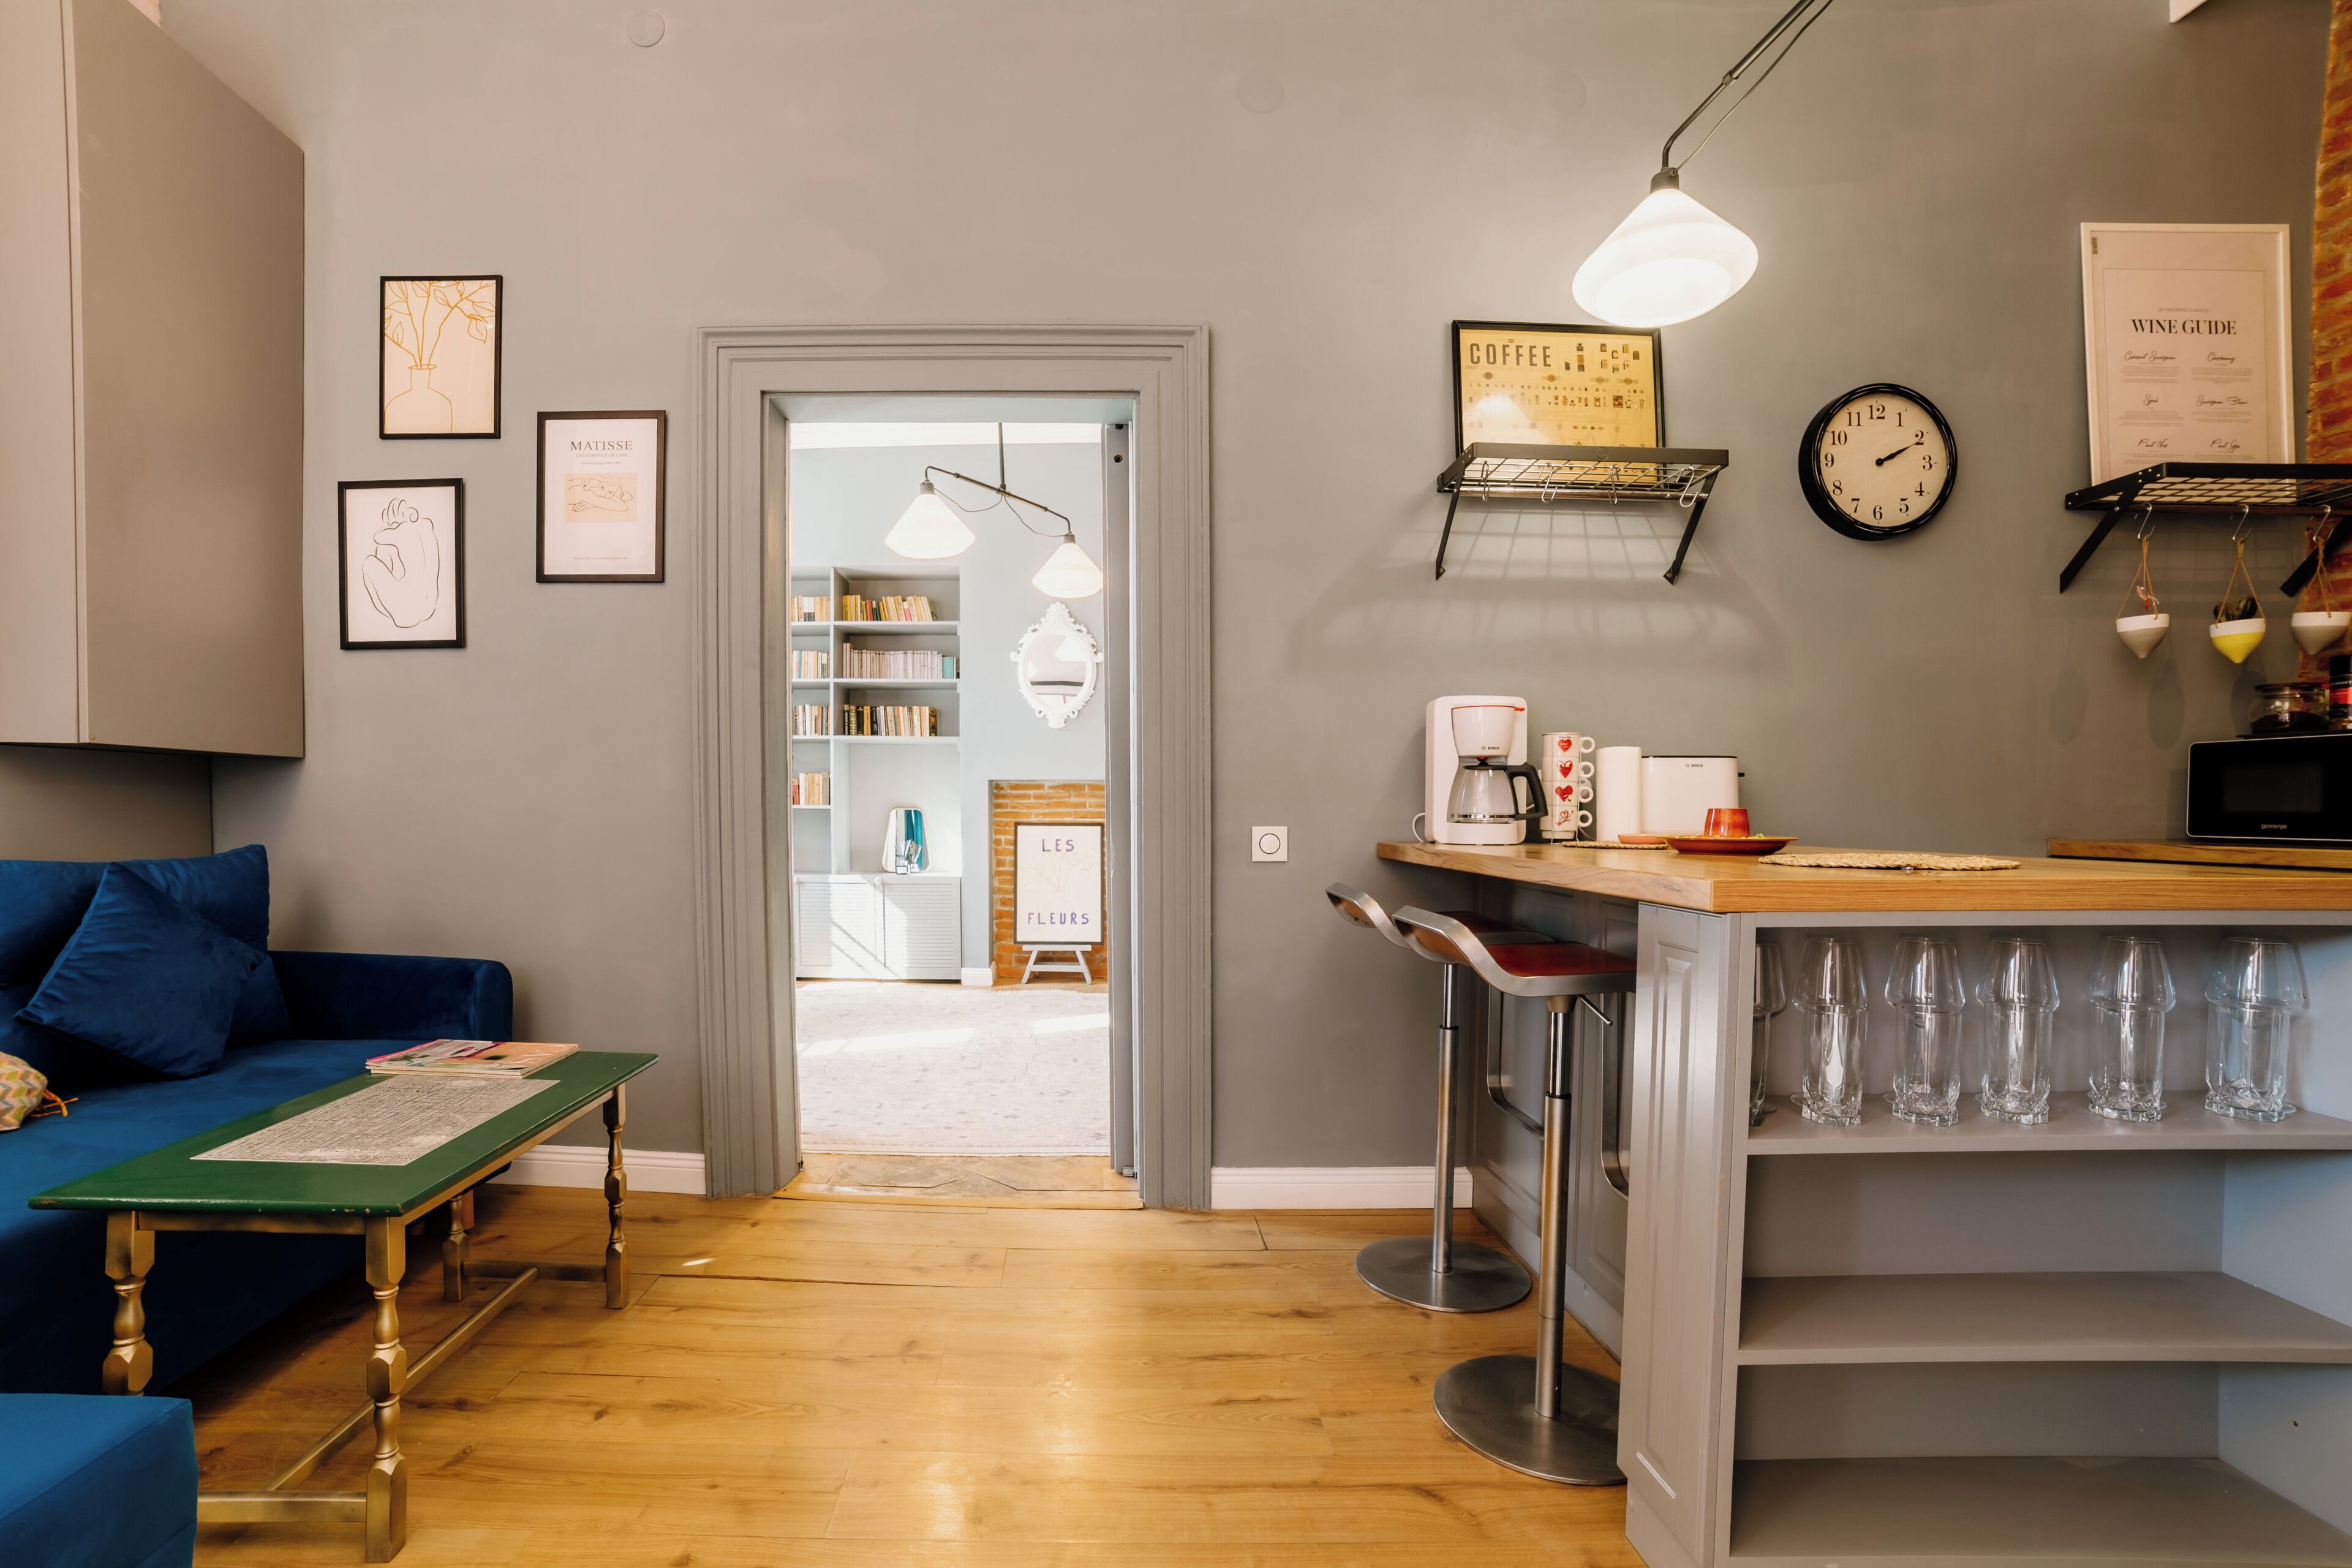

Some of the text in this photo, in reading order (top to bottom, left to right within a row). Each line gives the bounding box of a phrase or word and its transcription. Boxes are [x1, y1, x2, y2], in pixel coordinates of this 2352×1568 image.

[2132, 319, 2236, 335] WINE GUIDE
[1470, 343, 1551, 367] COFFEE
[1845, 411, 1863, 426] 11
[1868, 404, 1886, 420] 12
[1896, 412, 1904, 427] 1
[1829, 430, 1847, 445] 10
[1914, 430, 1924, 445] 2
[570, 440, 633, 451] MATISSE
[1824, 453, 1834, 468] 9
[1922, 454, 1932, 470] 3
[1832, 480, 1842, 496] 8
[1914, 481, 1924, 496] 4
[1851, 498, 1860, 513] 7
[1872, 505, 1883, 520] 6
[1899, 498, 1909, 513] 5
[1042, 839, 1074, 852] LES
[1028, 912, 1089, 925] FLEURS
